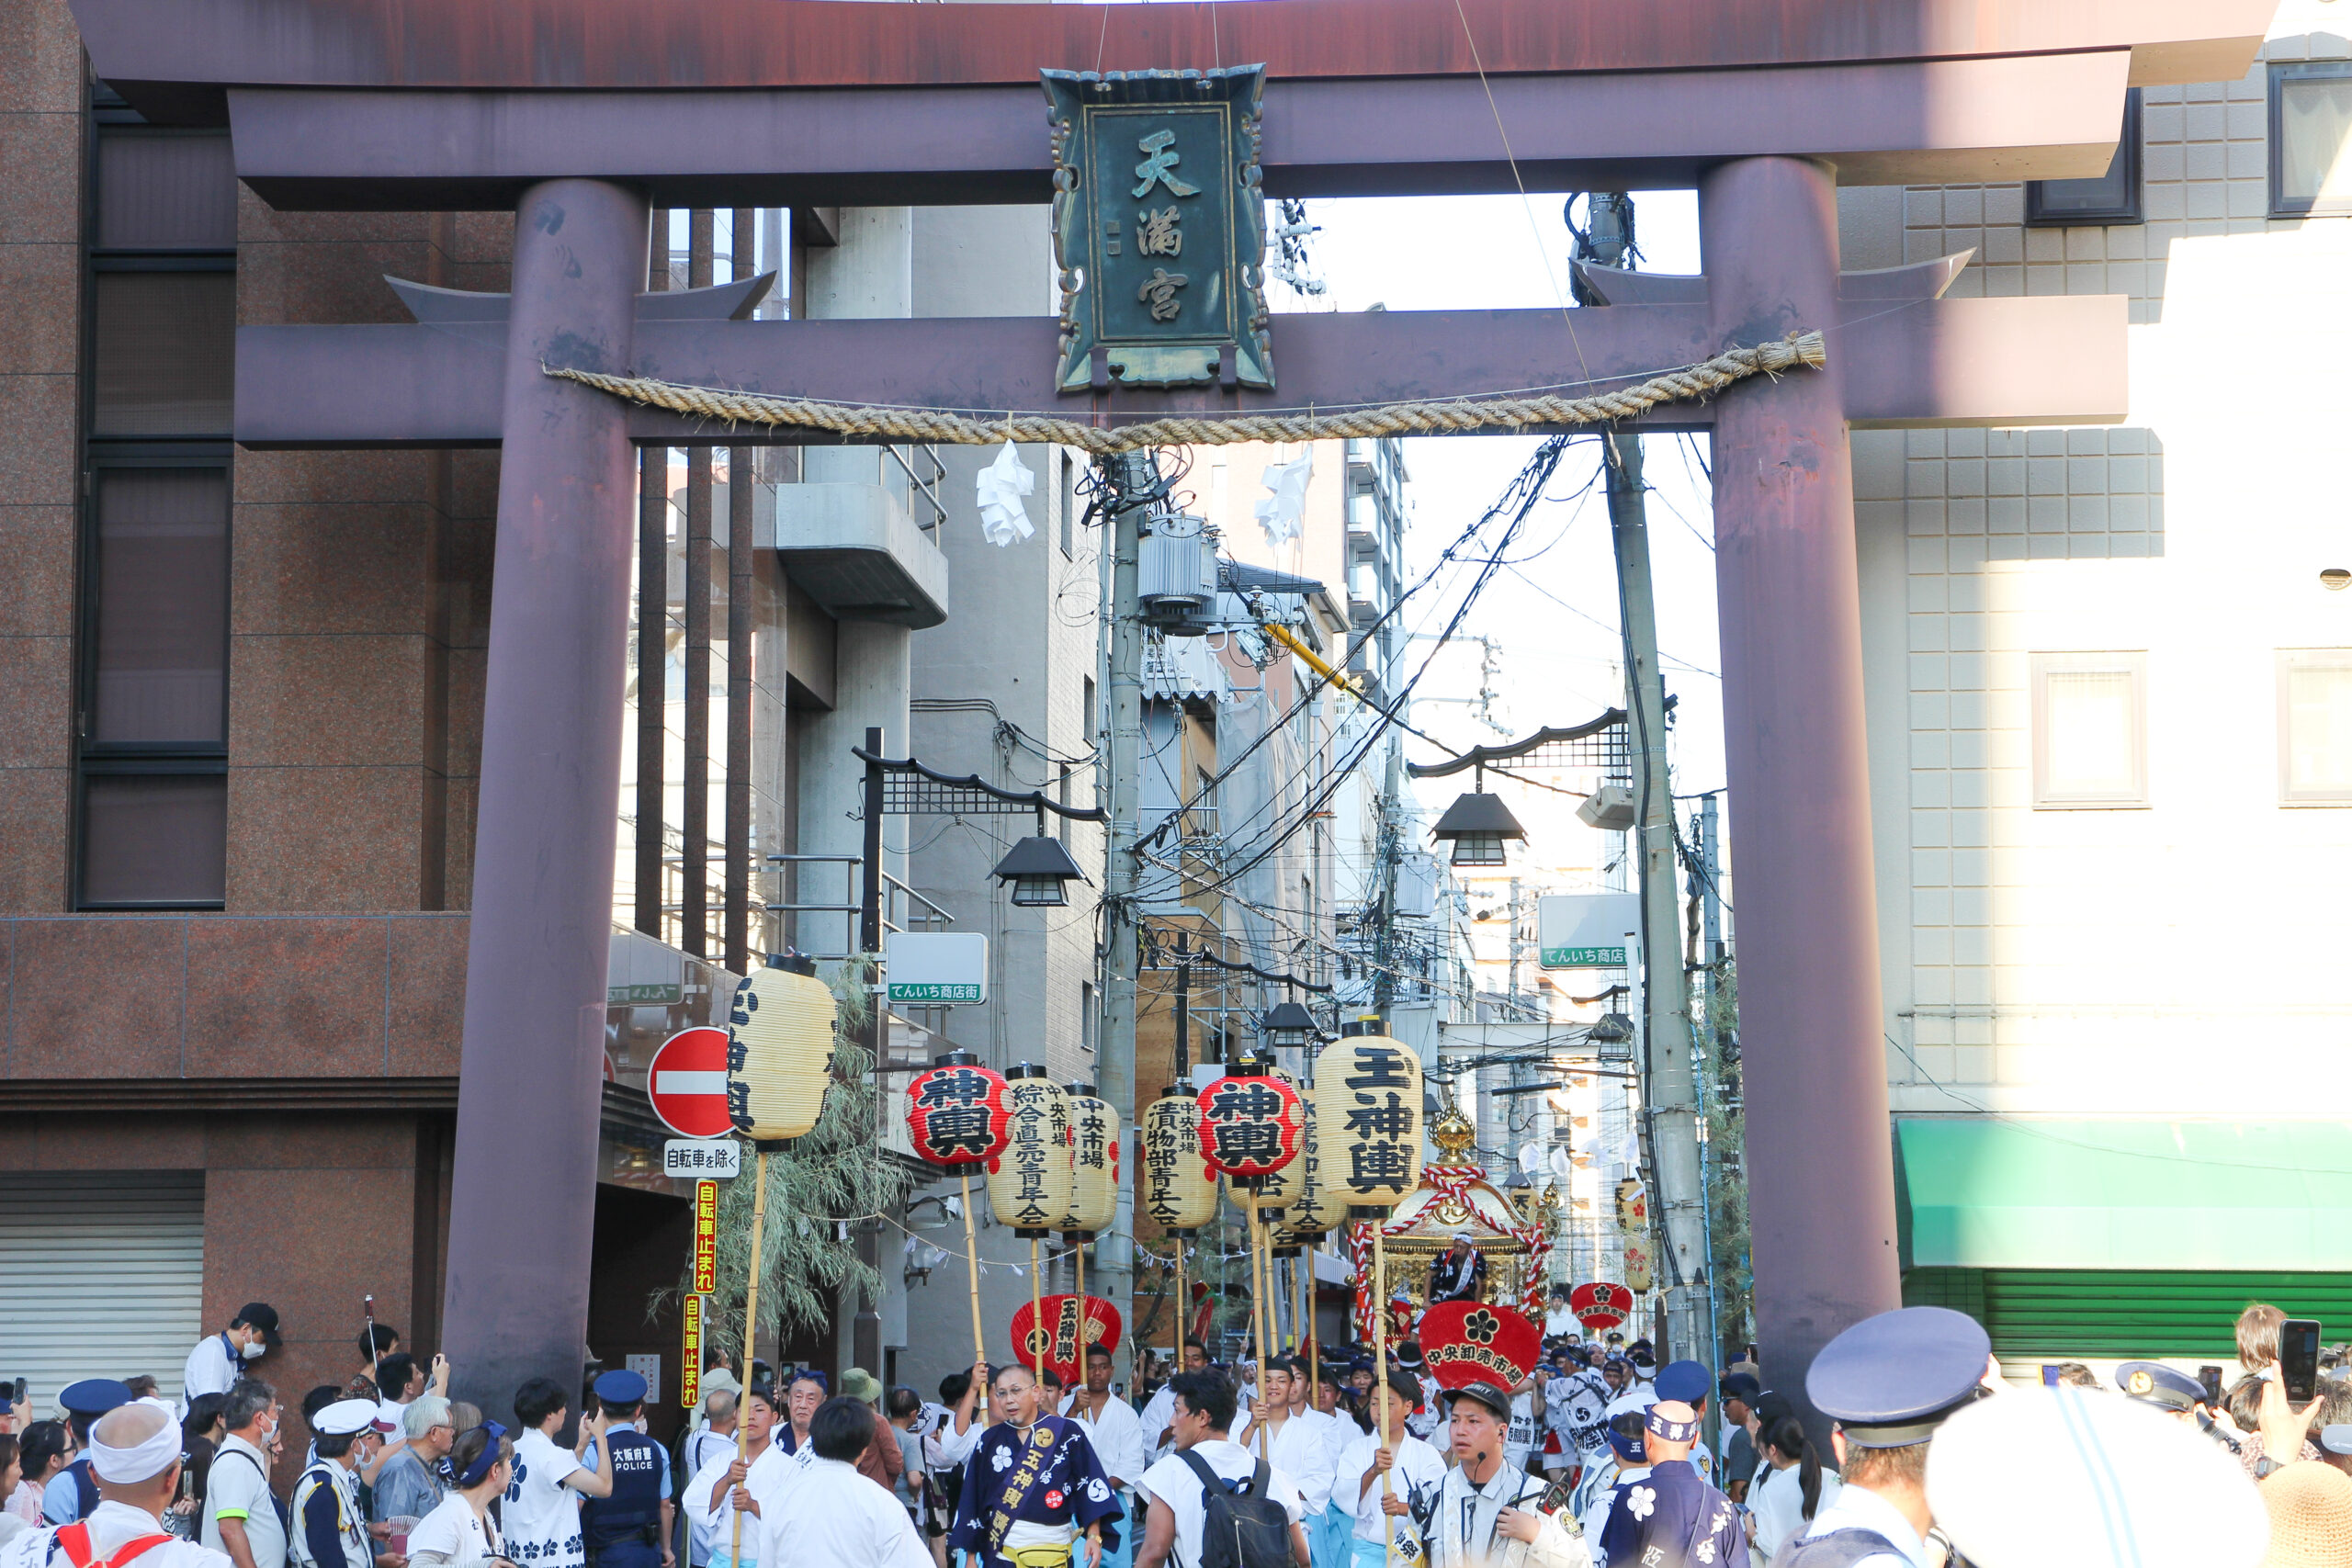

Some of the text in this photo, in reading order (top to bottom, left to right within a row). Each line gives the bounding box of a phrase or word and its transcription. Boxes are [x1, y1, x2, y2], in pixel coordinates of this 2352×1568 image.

[1545, 949, 1627, 963] てんいち商店
[891, 985, 978, 998] てんいち商店街
[918, 1069, 994, 1156] 神輿
[1046, 1084, 1068, 1147] 中央市場
[1079, 1099, 1105, 1169] 中央市場
[1179, 1101, 1196, 1155] 中央市場
[1207, 1083, 1283, 1167] 神輿
[1344, 1047, 1415, 1194] 玉神輿
[667, 1149, 736, 1168] 自転車を除く
[697, 1185, 715, 1290] 自転車止まれ
[684, 1299, 698, 1403] 自転車止まれ
[1056, 1300, 1077, 1361] 玉神輿
[1427, 1344, 1524, 1385] 中央卸売市場
[614, 1447, 651, 1461] 大阪府警
[616, 1461, 653, 1472] POLICE
